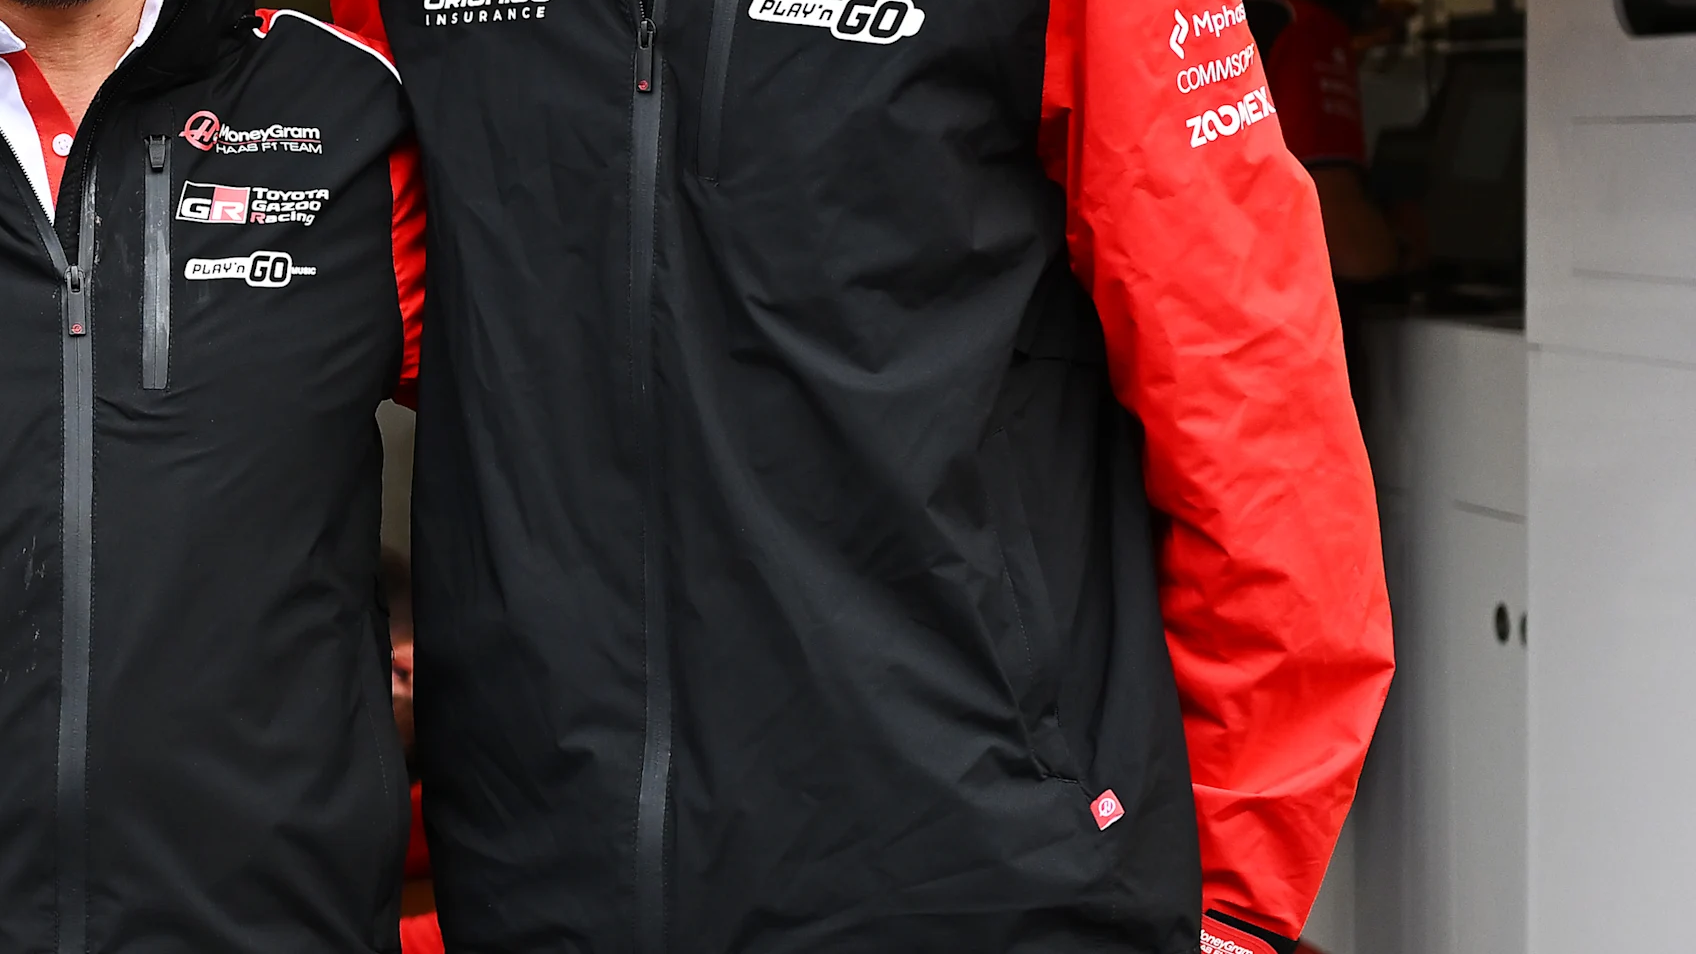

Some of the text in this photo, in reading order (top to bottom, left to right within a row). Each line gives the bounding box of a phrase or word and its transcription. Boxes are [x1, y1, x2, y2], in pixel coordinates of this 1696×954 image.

[425, 6, 546, 26] INSURANCE
[1192, 0, 1246, 38] Mphas
[1185, 86, 1276, 148] ZOOMEX
[219, 123, 320, 144] MoneyGram
[216, 141, 323, 155] HAAS F1 TEAM
[253, 187, 330, 201] TOYOTA
[180, 197, 244, 221] GR
[251, 200, 321, 212] GAZOO
[249, 211, 315, 226] Racing
[249, 255, 289, 283] GO
[291, 266, 317, 276] MUSIC
